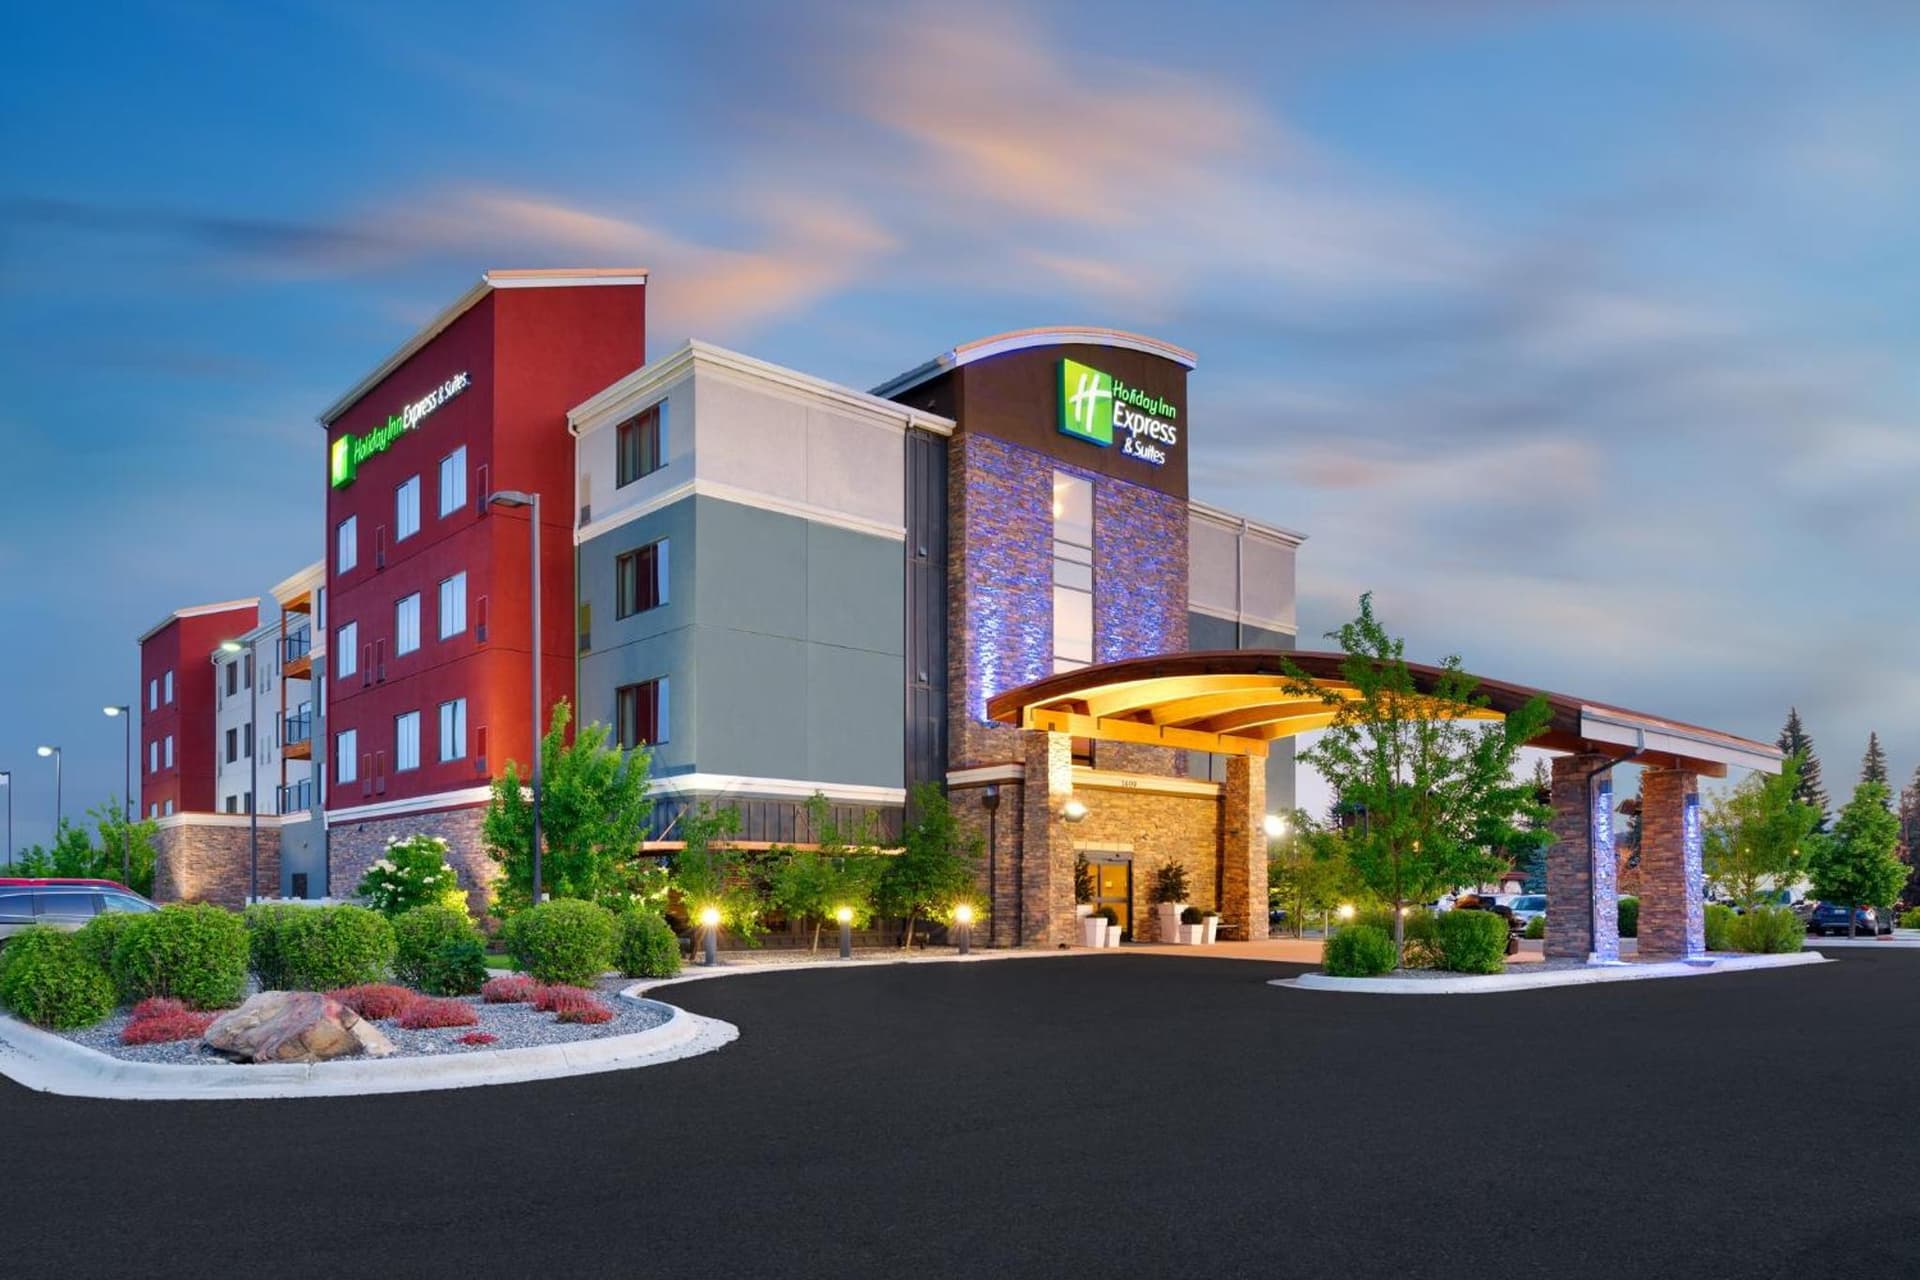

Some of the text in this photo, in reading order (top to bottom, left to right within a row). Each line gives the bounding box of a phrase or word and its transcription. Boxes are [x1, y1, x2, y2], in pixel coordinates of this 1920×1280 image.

[353, 427, 387, 464] Holiday
[388, 415, 403, 438] Inn
[402, 390, 437, 429] Express
[437, 385, 446, 404] &
[444, 371, 467, 397] Suites
[1113, 380, 1176, 418] Holiday Inn
[1113, 400, 1177, 445] Express
[1124, 437, 1166, 464] & Suites
